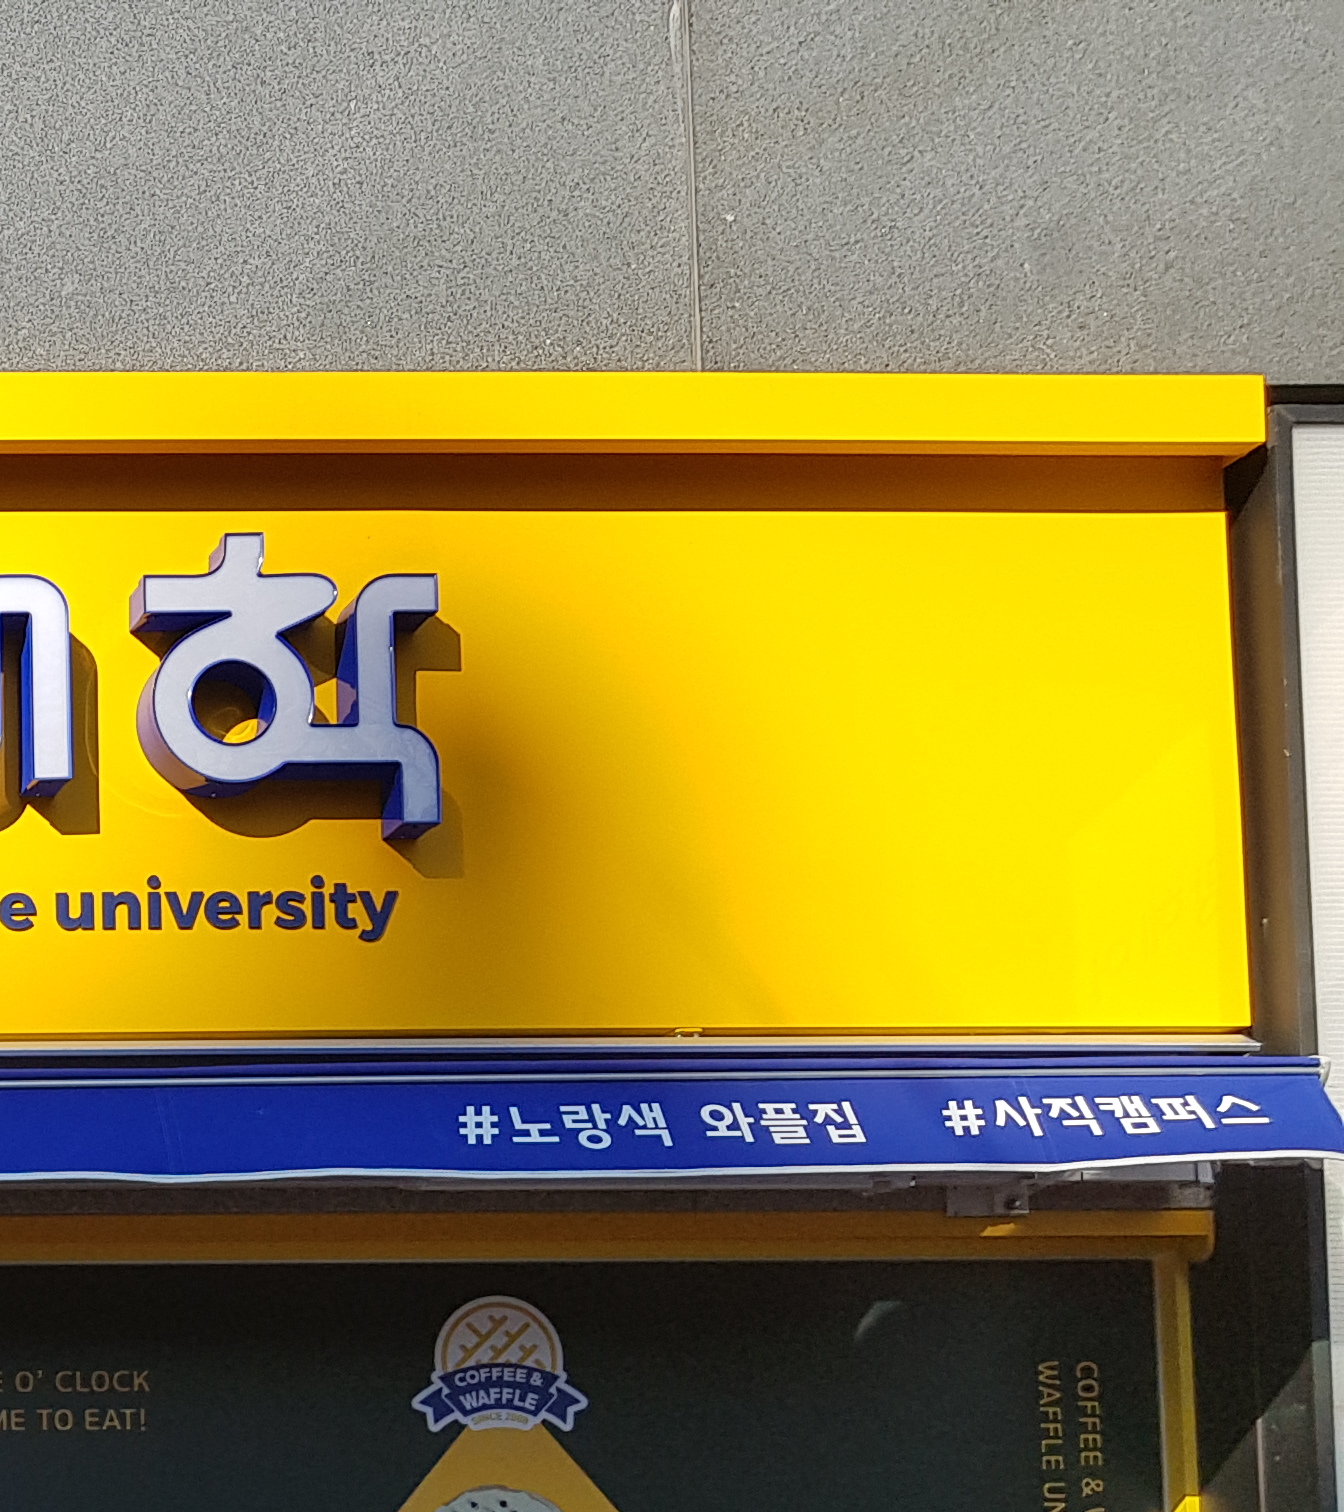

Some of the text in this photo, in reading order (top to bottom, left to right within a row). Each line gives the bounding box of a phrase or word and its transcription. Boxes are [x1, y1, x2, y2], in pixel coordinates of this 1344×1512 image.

[54, 875, 400, 943] university
[457, 1094, 1272, 1150] #노랑색 와플집 #사직캠퍼스
[55, 1370, 151, 1393] CLOCK
[454, 1367, 544, 1387] COFFEE &
[459, 1387, 539, 1411] WAFFLE
[36, 1409, 74, 1431] TO
[84, 1408, 147, 1431] EAT!
[1037, 1360, 1064, 1470] WAFFLE
[1075, 1360, 1103, 1467] COFFEE
[1081, 1477, 1104, 1498] &
